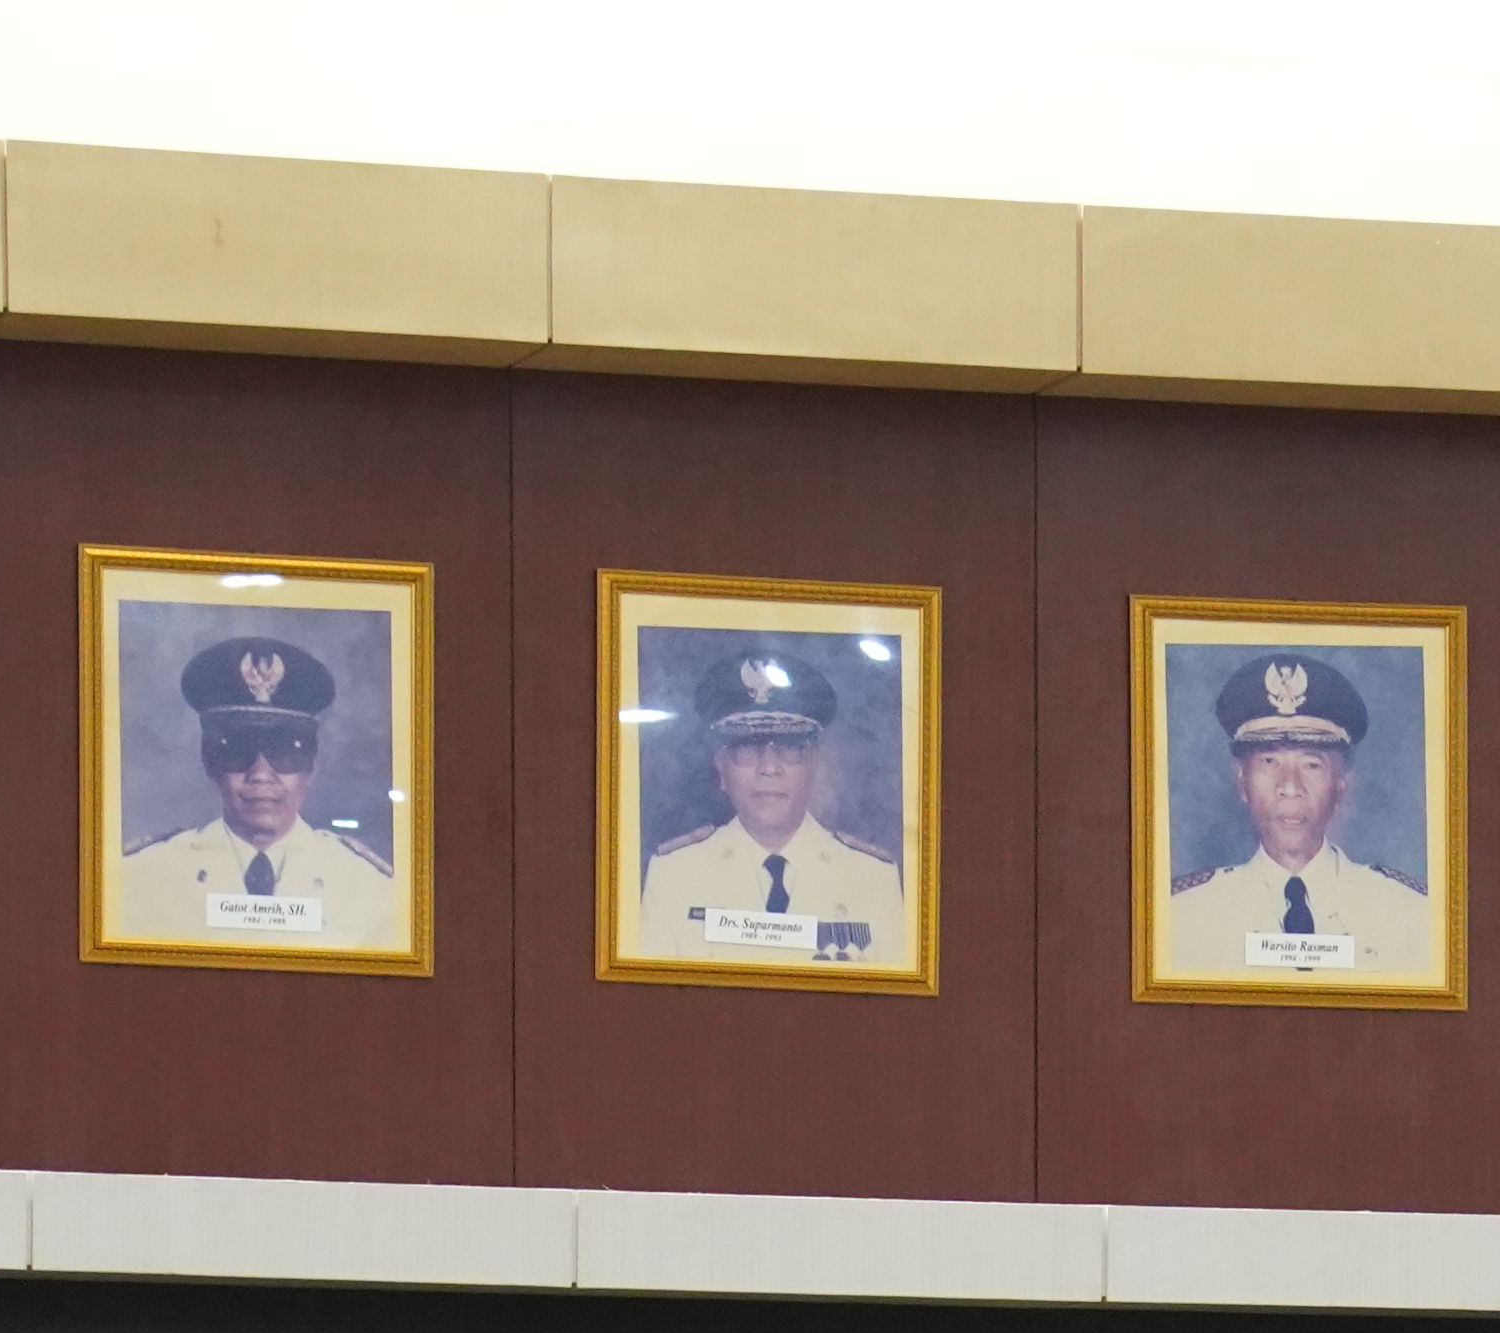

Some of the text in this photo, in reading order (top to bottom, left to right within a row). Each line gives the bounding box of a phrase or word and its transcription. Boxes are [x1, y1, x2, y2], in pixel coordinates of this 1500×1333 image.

[220, 900, 247, 914] Gatot
[742, 917, 803, 934] Suparmanto
[1260, 939, 1339, 953] Warsito Rasman
